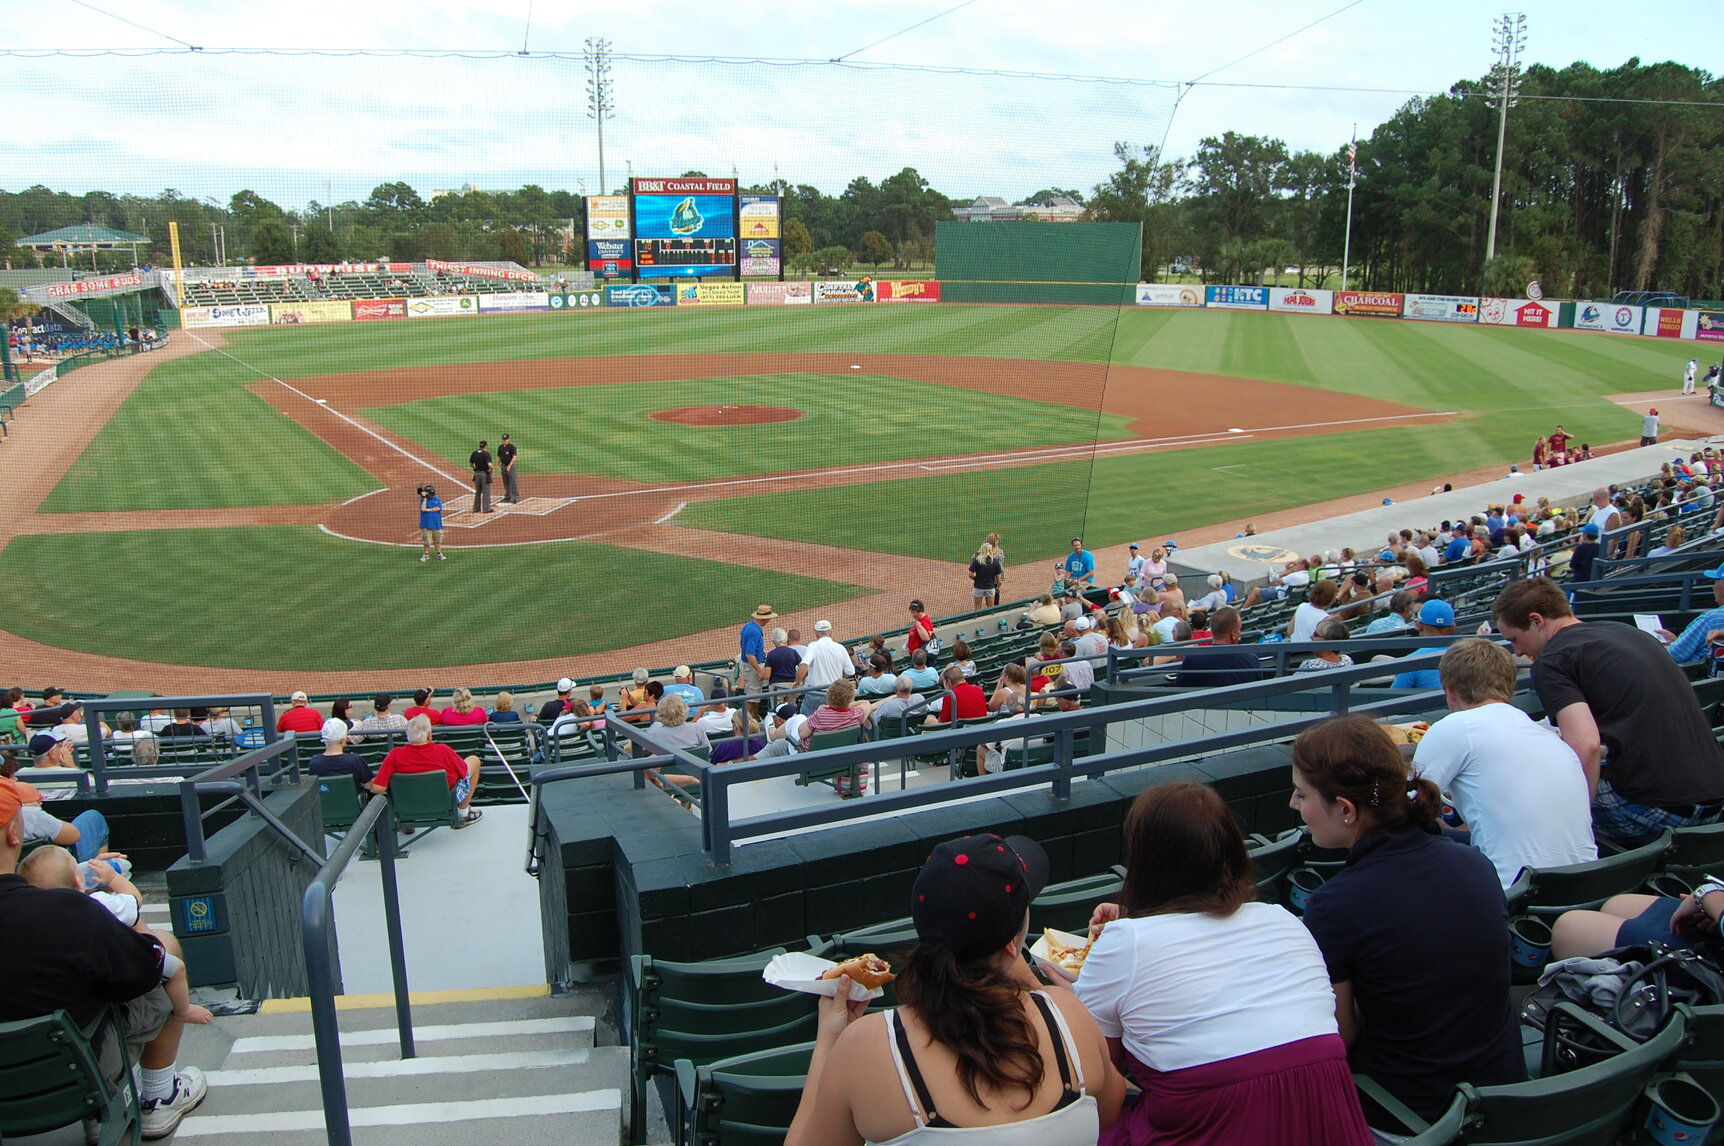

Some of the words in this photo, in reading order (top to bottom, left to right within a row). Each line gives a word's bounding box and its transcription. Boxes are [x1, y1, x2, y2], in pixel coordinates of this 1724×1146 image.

[637, 180, 666, 192] BB&T
[667, 182, 705, 191] COASTAL
[706, 182, 731, 191] FIELD
[596, 241, 624, 250] Webster
[429, 261, 467, 273] THIRST
[469, 266, 505, 278] INNING
[508, 271, 535, 282] DECK
[48, 283, 78, 297] GRAB
[81, 279, 111, 292] SOME
[113, 275, 141, 288] BUDS
[890, 281, 925, 298] Wendy's
[1233, 287, 1263, 302] HTC
[1343, 295, 1400, 307] CHARCOAL
[1523, 308, 1536, 316] HIT
[1536, 308, 1543, 316] IT
[1522, 315, 1543, 323] HERE!
[1660, 316, 1681, 324] WELLS
[1044, 665, 1061, 675] 107
